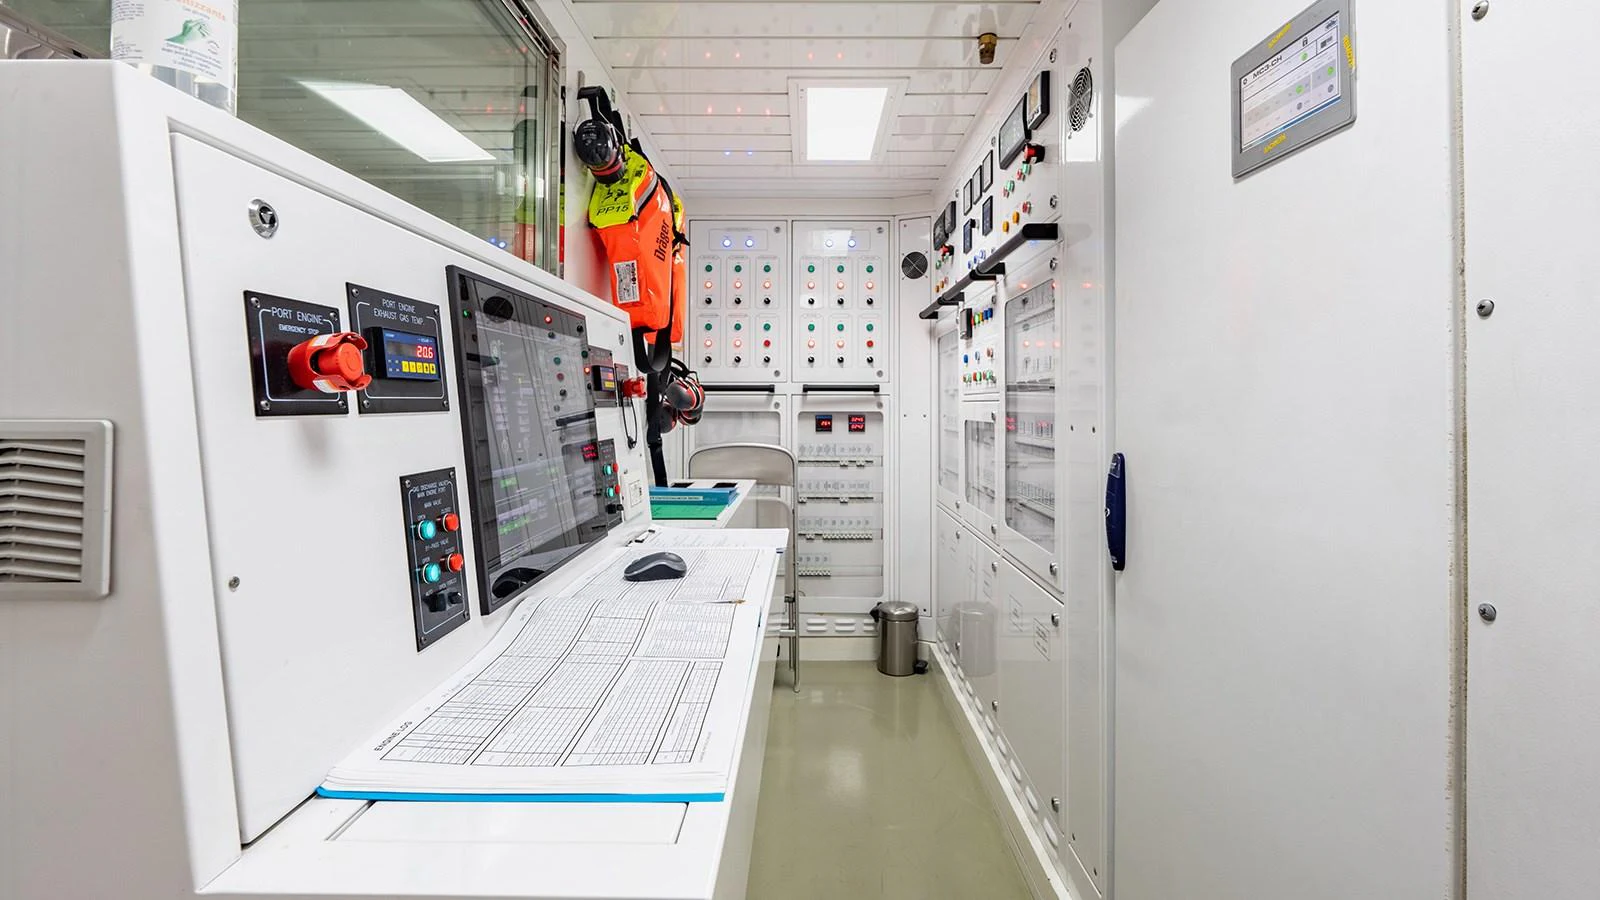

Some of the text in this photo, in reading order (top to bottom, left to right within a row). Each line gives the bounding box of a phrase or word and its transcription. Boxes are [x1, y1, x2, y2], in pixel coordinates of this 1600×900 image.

[1252, 55, 1282, 79] MC3-CH
[654, 219, 670, 262] Dräger
[382, 298, 416, 313] PORT ENGINE
[271, 306, 323, 324] PORT ENGINE
[373, 307, 397, 320] EXHAUST
[399, 313, 409, 323] GAS
[279, 323, 319, 335] EMERGENCY STOP
[374, 732, 400, 751] ENGINE
